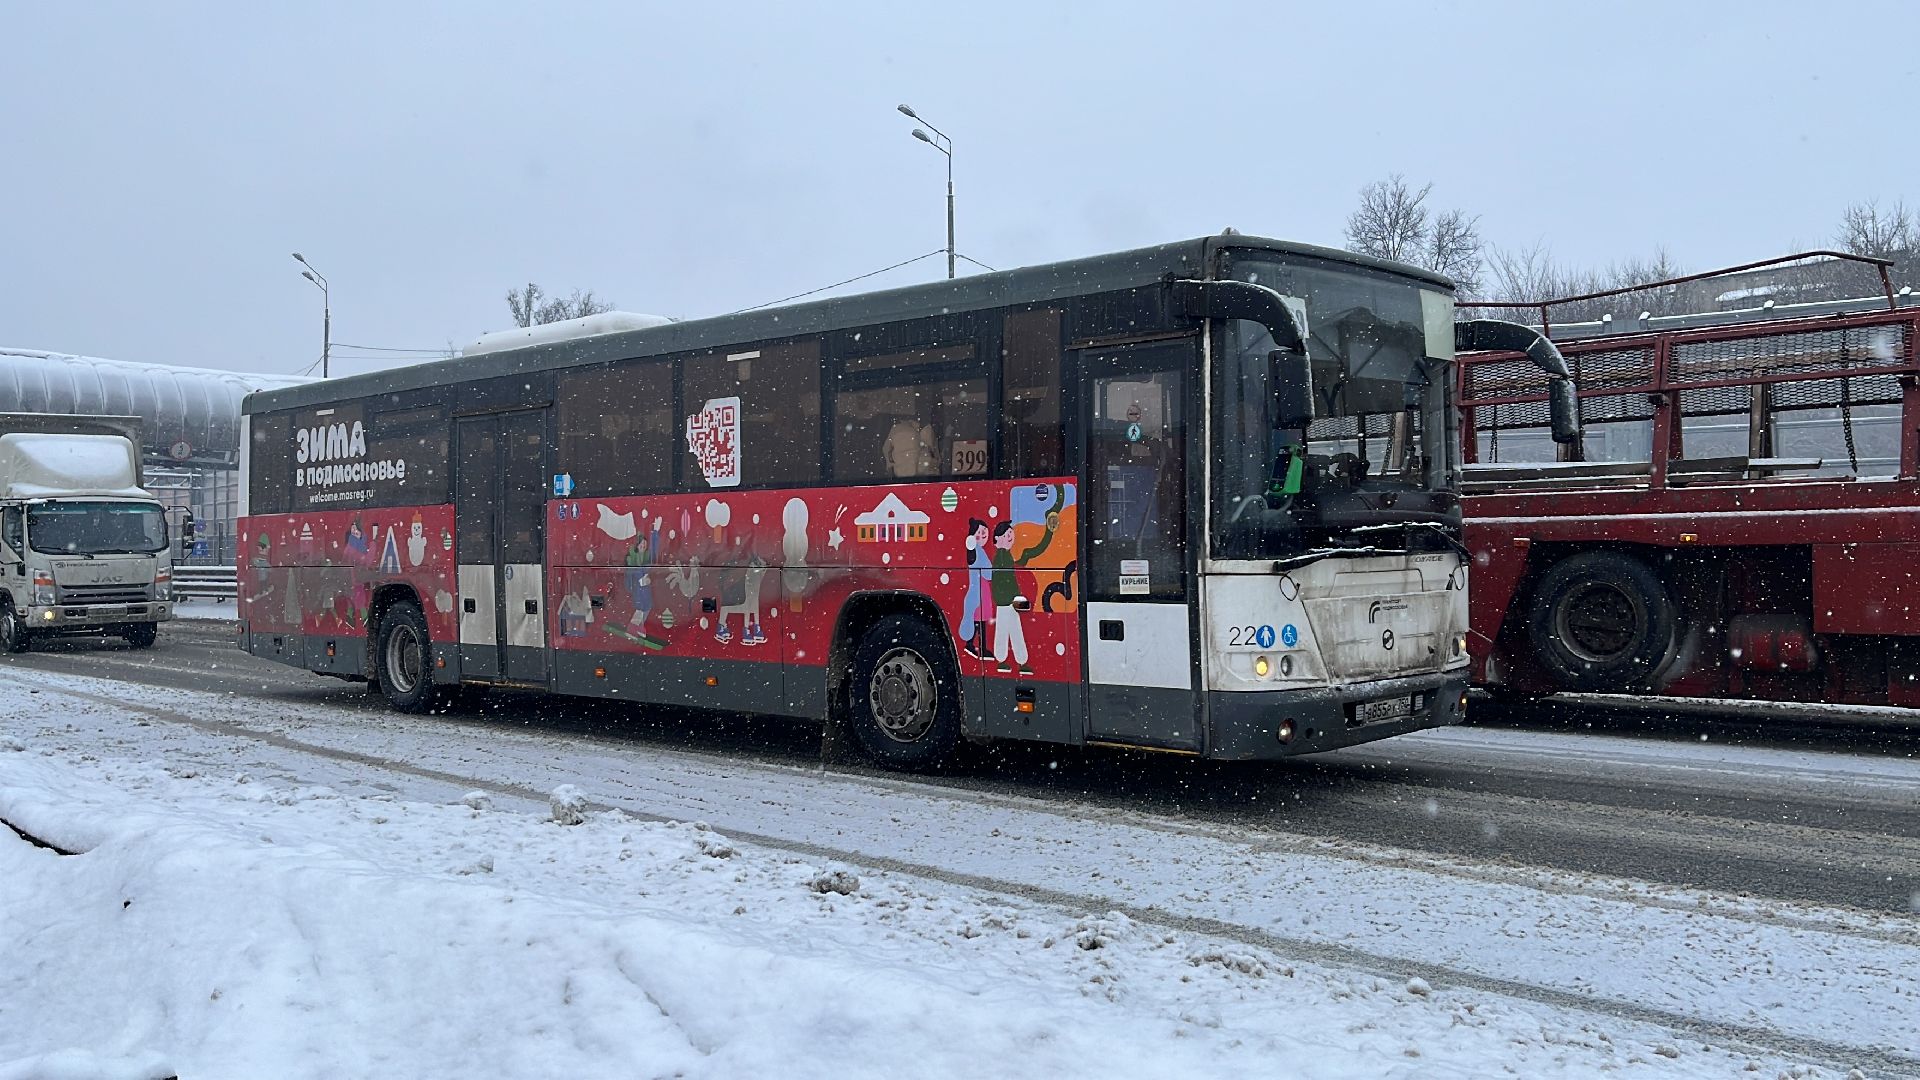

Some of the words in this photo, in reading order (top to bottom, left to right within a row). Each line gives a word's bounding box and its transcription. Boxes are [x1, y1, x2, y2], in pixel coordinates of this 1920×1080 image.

[297, 421, 366, 463] ЗИМА
[956, 450, 986, 472] 399
[1229, 625, 1256, 646] 22
